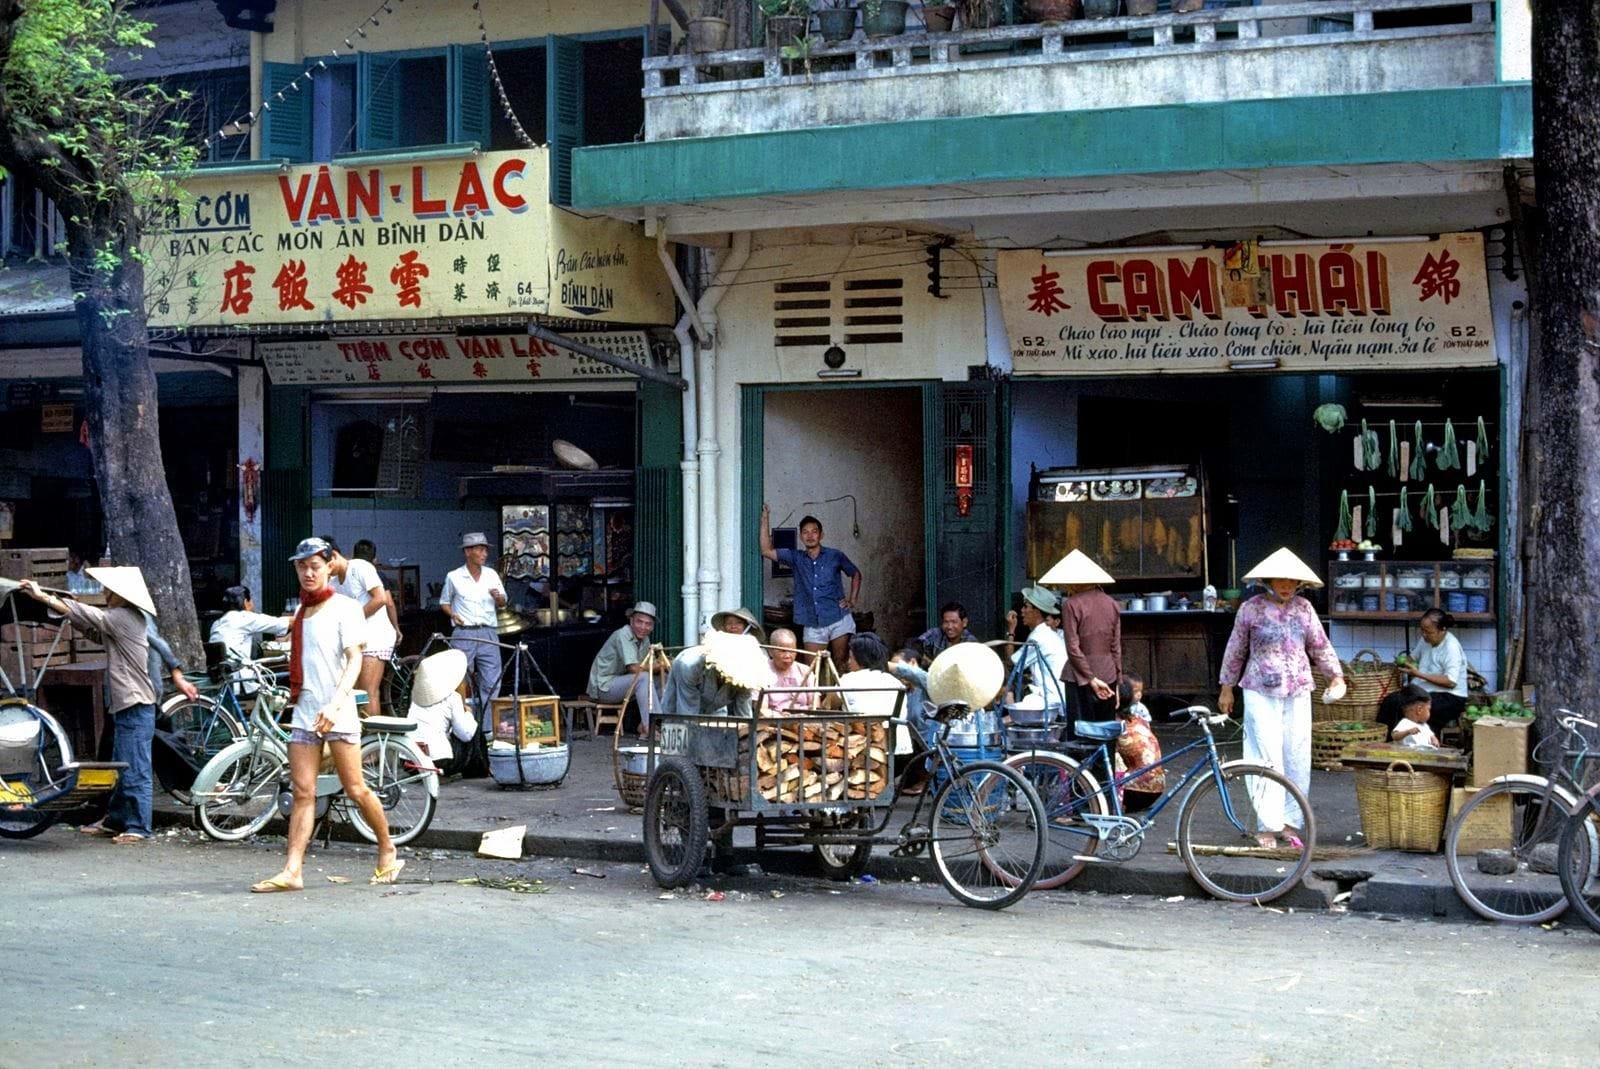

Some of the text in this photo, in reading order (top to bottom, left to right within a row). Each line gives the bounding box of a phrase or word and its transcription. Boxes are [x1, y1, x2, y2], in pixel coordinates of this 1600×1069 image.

[195, 191, 250, 226] CƠM
[170, 235, 210, 257] BÁN
[222, 232, 264, 254] CÁC
[277, 228, 323, 251] MÓN
[377, 222, 426, 246] BÌNH
[439, 219, 485, 242] DÂN
[517, 281, 533, 296] 64
[1412, 248, 1461, 305] 錦
[1027, 264, 1072, 317] 泰
[1059, 325, 1095, 340] Cháo
[1180, 322, 1218, 338] Cháo
[1224, 321, 1260, 340] lòng
[1267, 320, 1285, 336] bò
[1370, 317, 1408, 338] lòng
[1415, 316, 1435, 332] bò
[1451, 326, 1476, 337] 62
[399, 338, 450, 361] CƠM
[1022, 336, 1045, 346] 62
